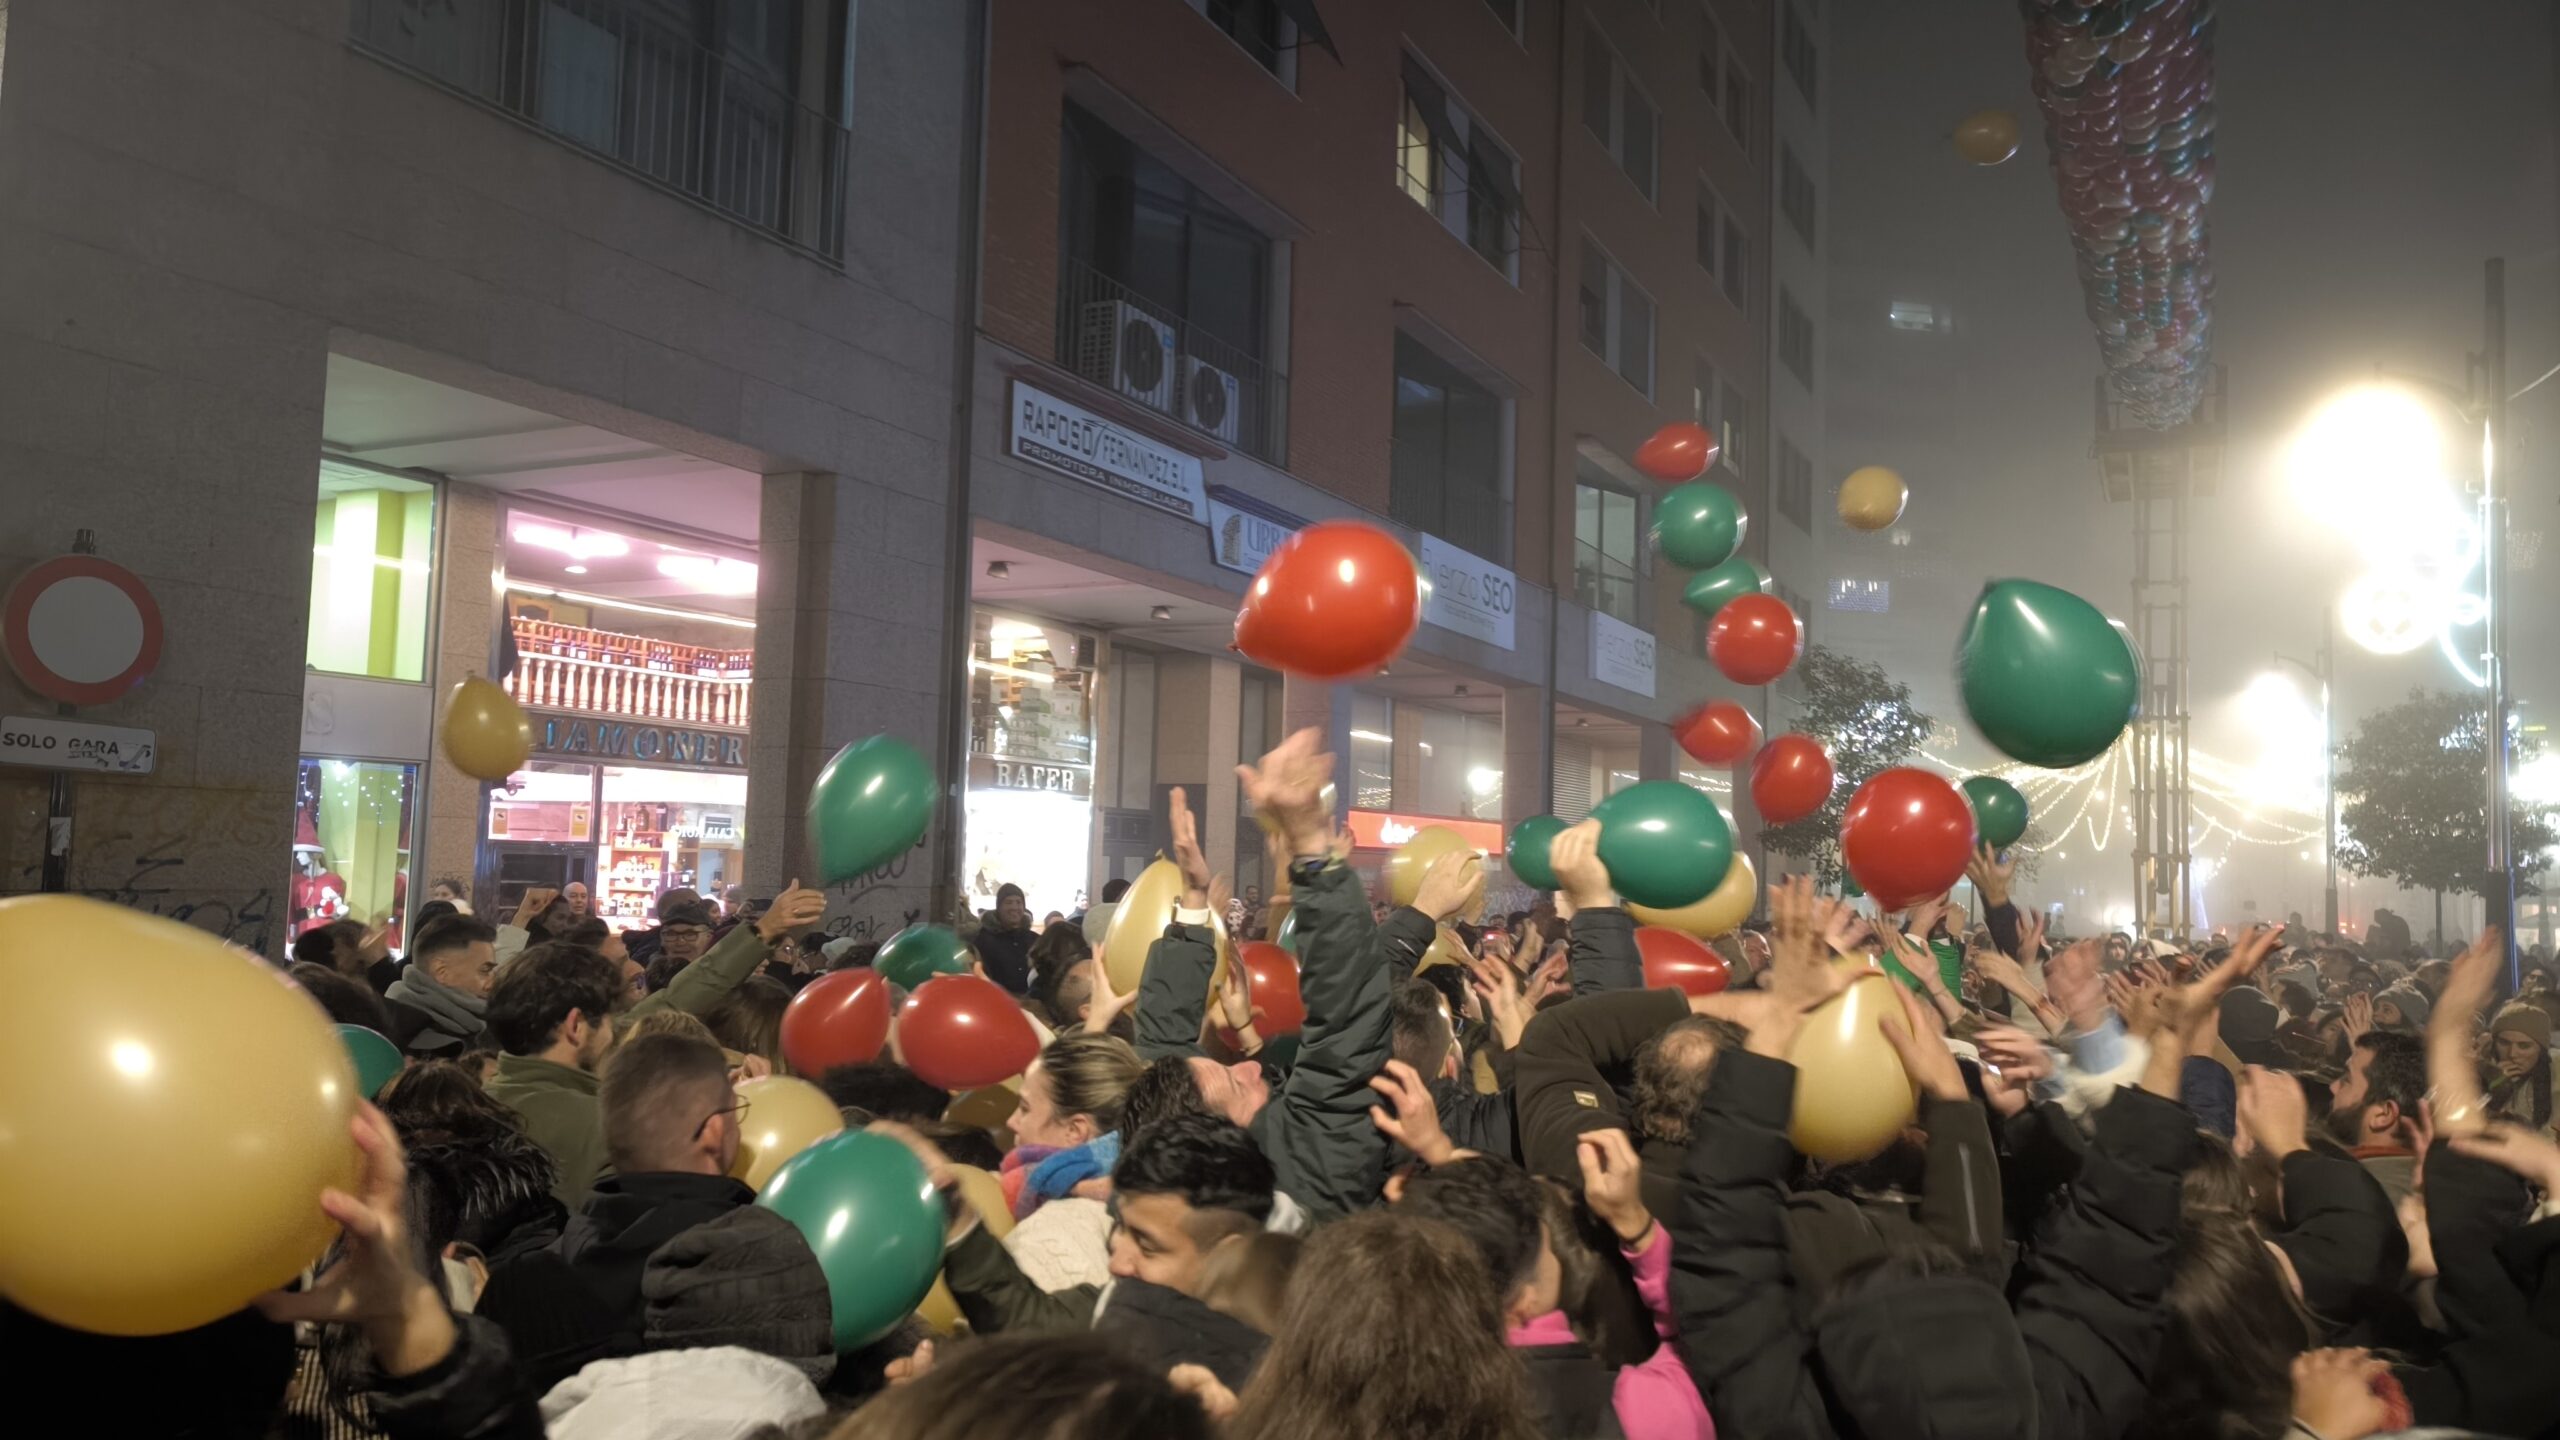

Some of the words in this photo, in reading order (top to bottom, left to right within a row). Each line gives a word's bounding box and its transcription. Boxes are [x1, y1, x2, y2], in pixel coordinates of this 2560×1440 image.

[1023, 399, 1093, 456] RAPOSO
[1022, 441, 1106, 481] PROMOTORA
[1108, 475, 1191, 513] INMOBILIARIA
[2, 732, 57, 750] SOLO
[996, 762, 1075, 792] RAFER
